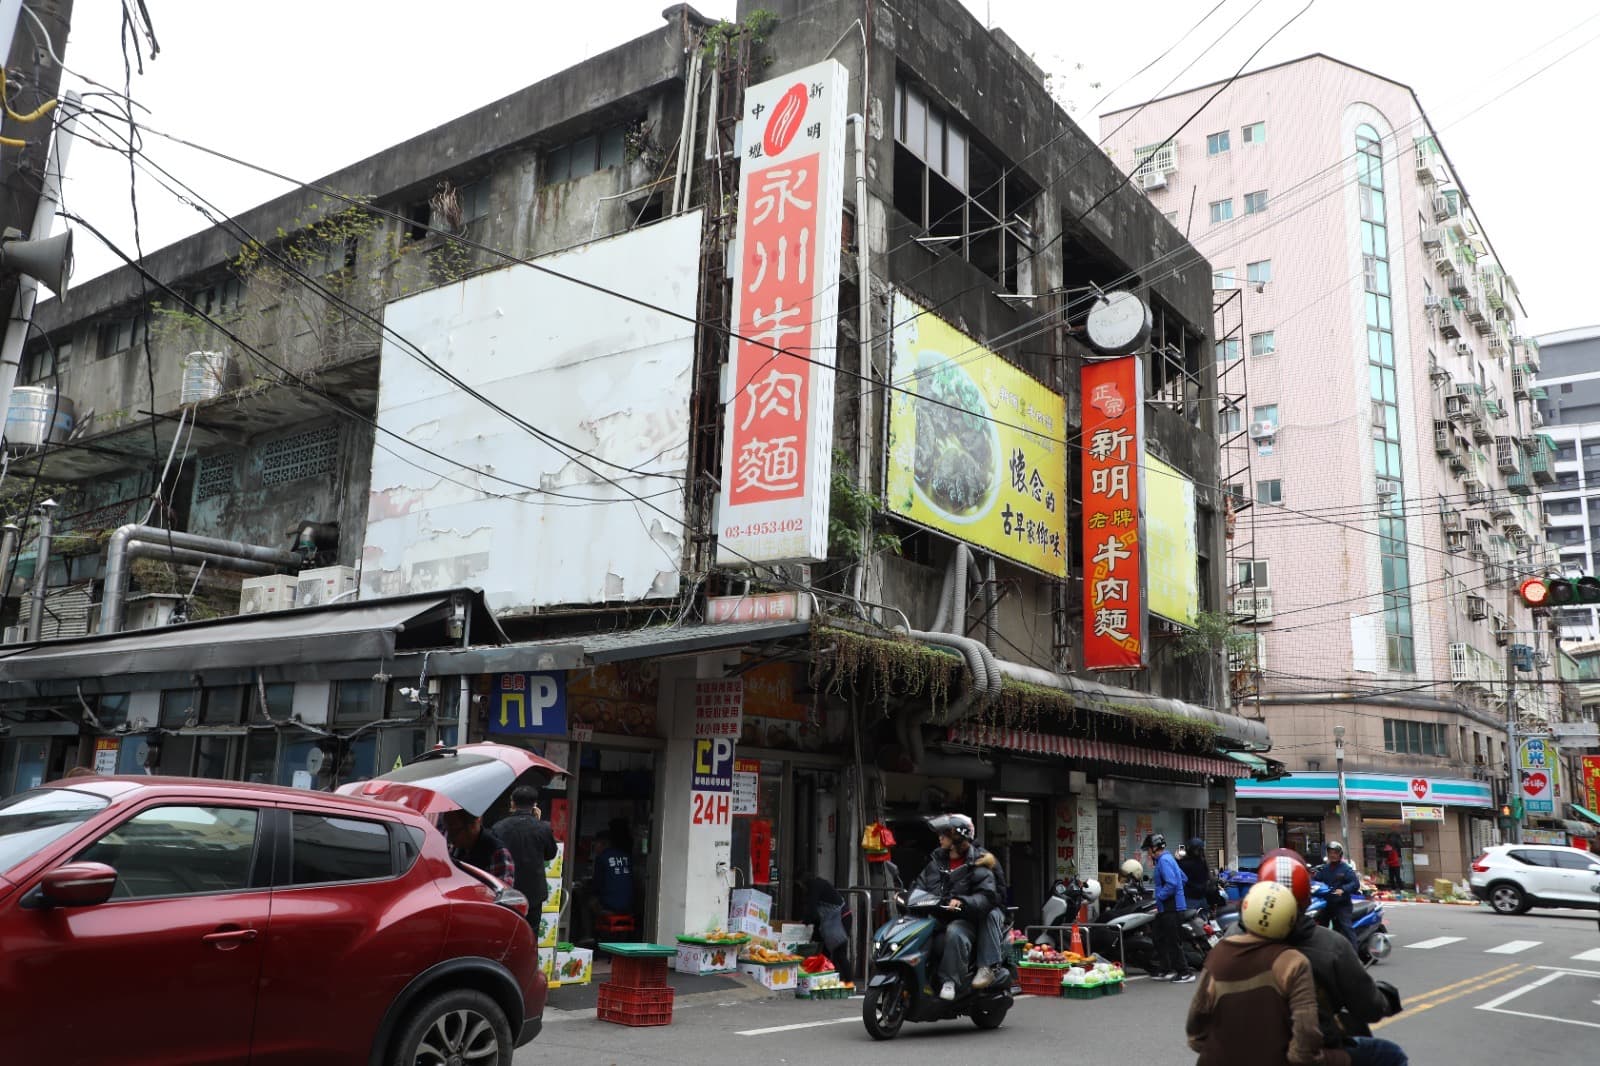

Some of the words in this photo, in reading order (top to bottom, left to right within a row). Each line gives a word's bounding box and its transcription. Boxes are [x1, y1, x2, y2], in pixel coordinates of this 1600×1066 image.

[807, 81, 825, 140] 新明
[736, 168, 813, 493] 永川牛肉麵
[1094, 385, 1123, 413] 正宗
[1009, 447, 1055, 513] 懷念的
[1088, 427, 1134, 501] 新明
[725, 518, 804, 538] 03-4953402
[1088, 508, 1135, 530] 老牌
[1092, 535, 1132, 642] 牛肉麵
[530, 675, 558, 726] P
[711, 738, 732, 775] P
[693, 793, 729, 825] 24H
